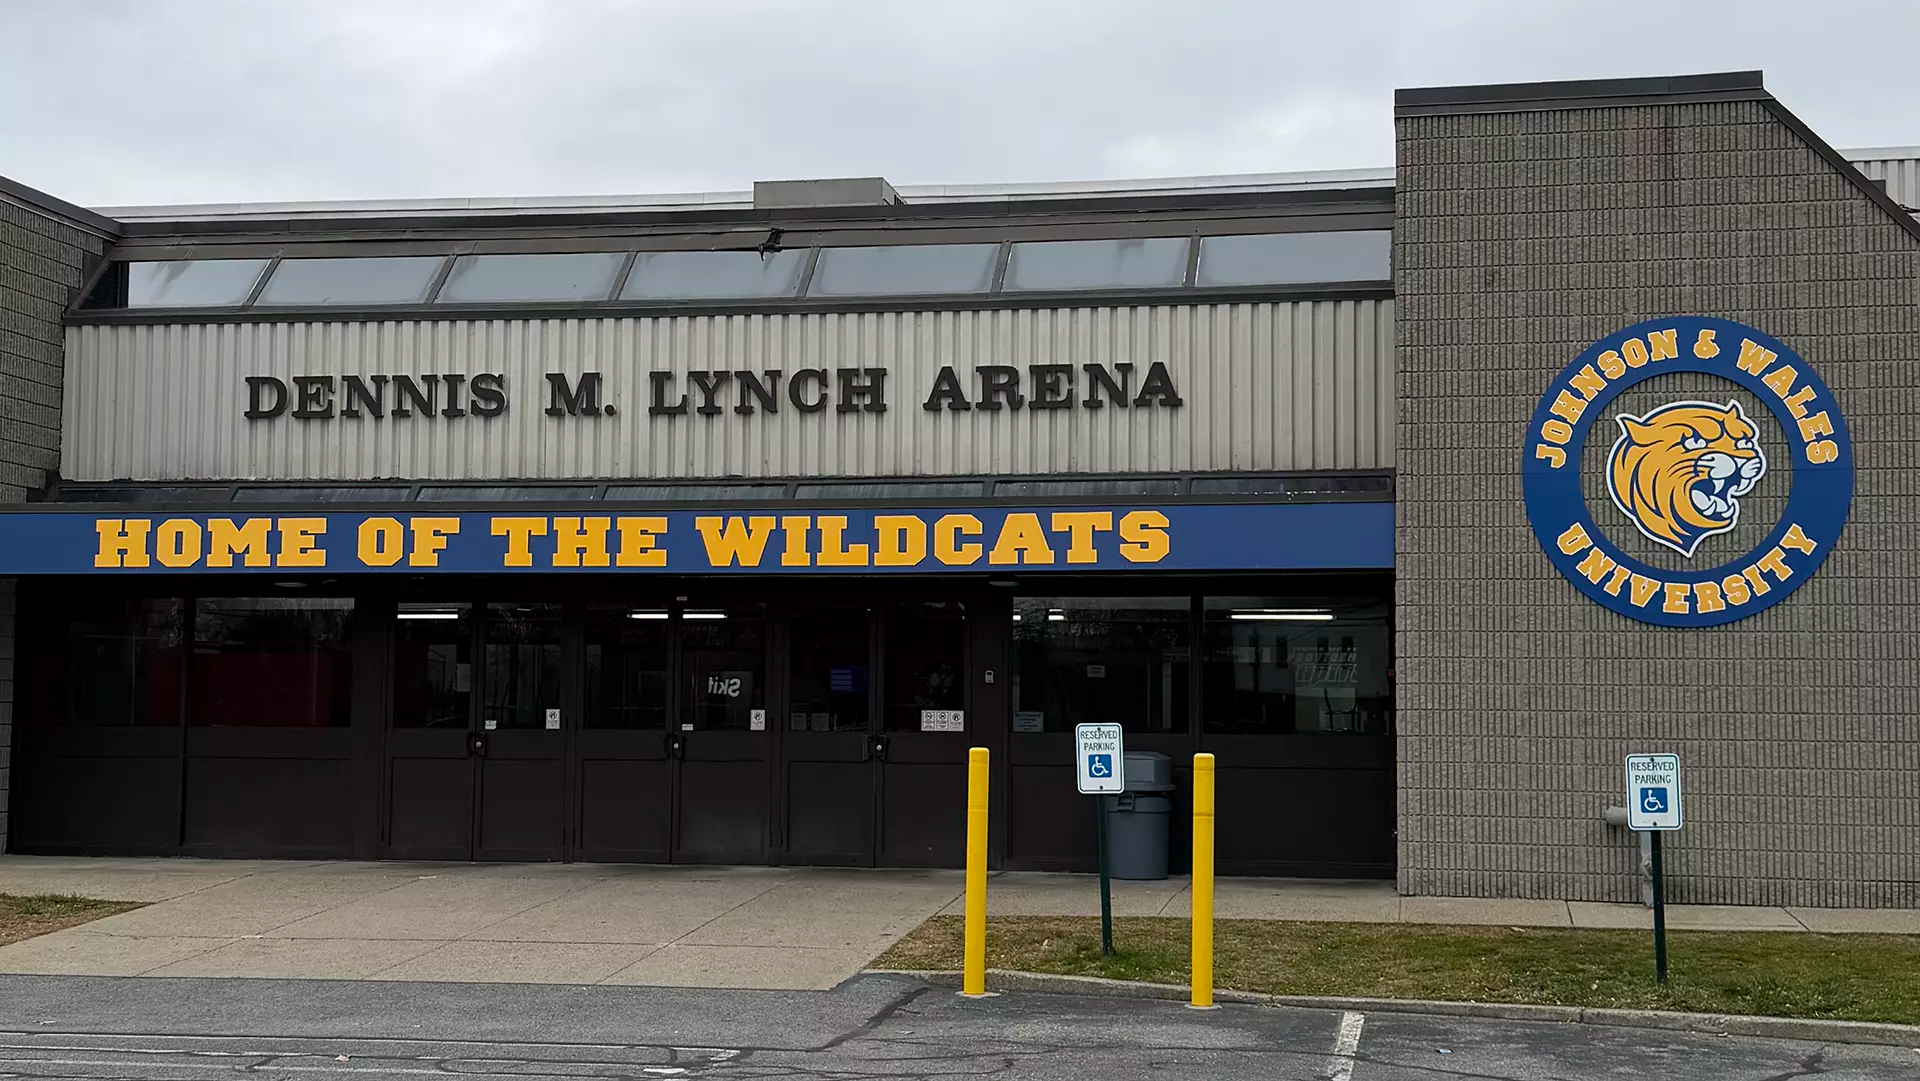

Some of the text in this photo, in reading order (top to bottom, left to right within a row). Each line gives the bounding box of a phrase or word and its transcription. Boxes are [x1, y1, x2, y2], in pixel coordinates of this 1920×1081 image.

[244, 361, 1184, 419] DENNIS M. LYNCH ARENA
[1535, 328, 1839, 469] JOHNSON & WALES
[94, 510, 1171, 569] HOME OF THE WILDCATS
[1556, 521, 1819, 615] UNIVERSITY
[1080, 730, 1118, 740] RESERVED
[1084, 742, 1115, 751] PARKING
[1630, 761, 1675, 772] RESERVED
[1634, 774, 1672, 784] PARKING
